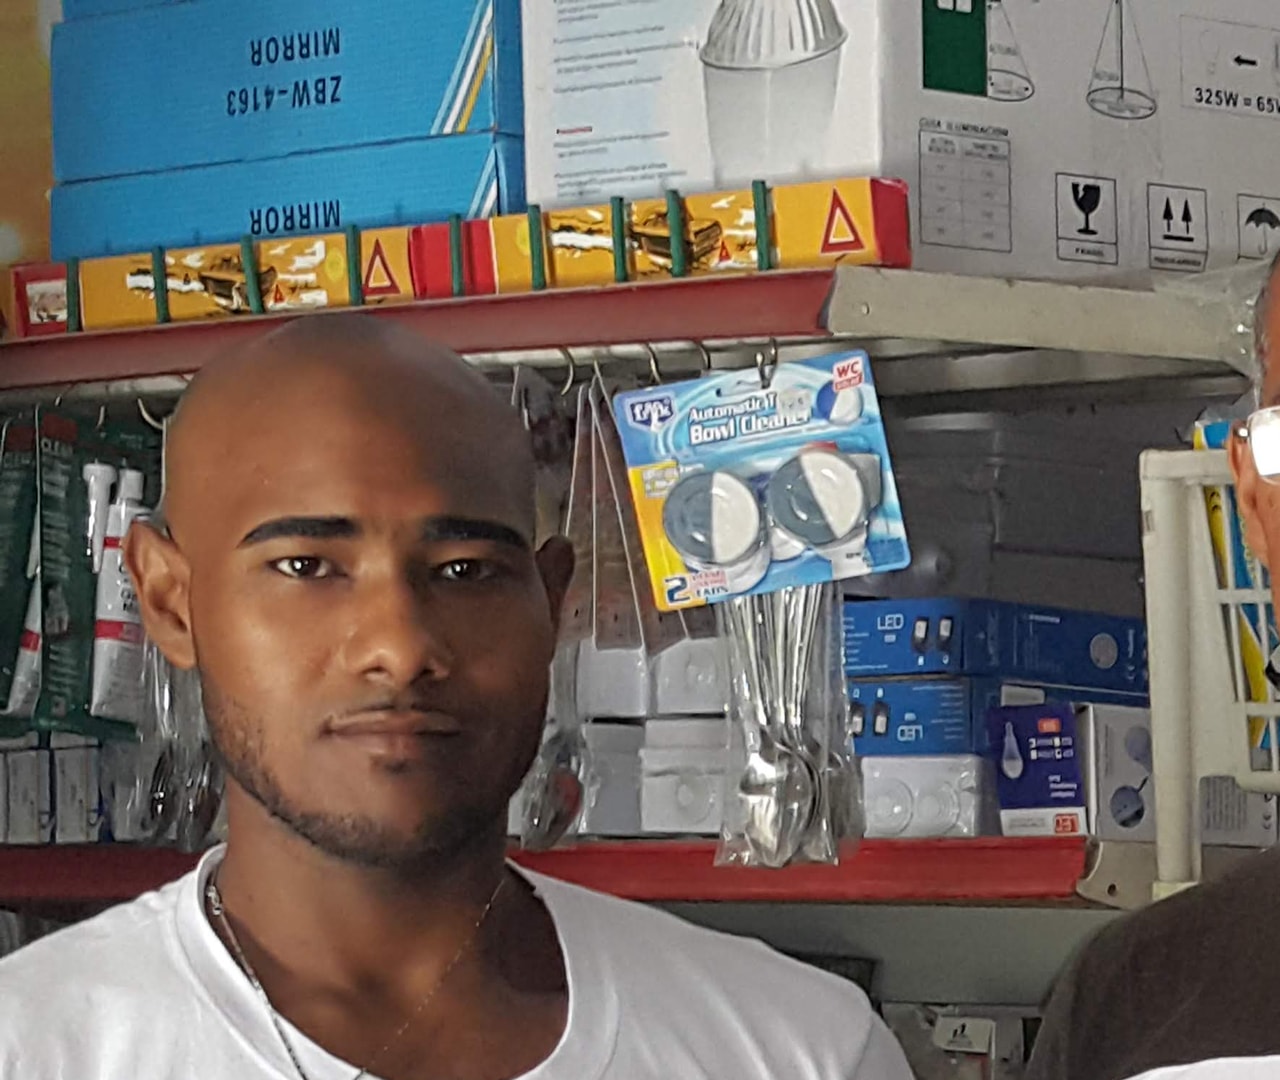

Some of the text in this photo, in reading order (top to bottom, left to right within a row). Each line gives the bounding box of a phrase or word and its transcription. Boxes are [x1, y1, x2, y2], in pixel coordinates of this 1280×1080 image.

[250, 27, 341, 65] MIRROR
[227, 75, 342, 115] ZBW-4163
[1195, 87, 1238, 108] 325W
[250, 200, 341, 234] MIRROR
[836, 361, 861, 377] WC
[689, 396, 762, 421] Automatic
[690, 422, 735, 445] Bowl
[665, 577, 690, 603] 2
